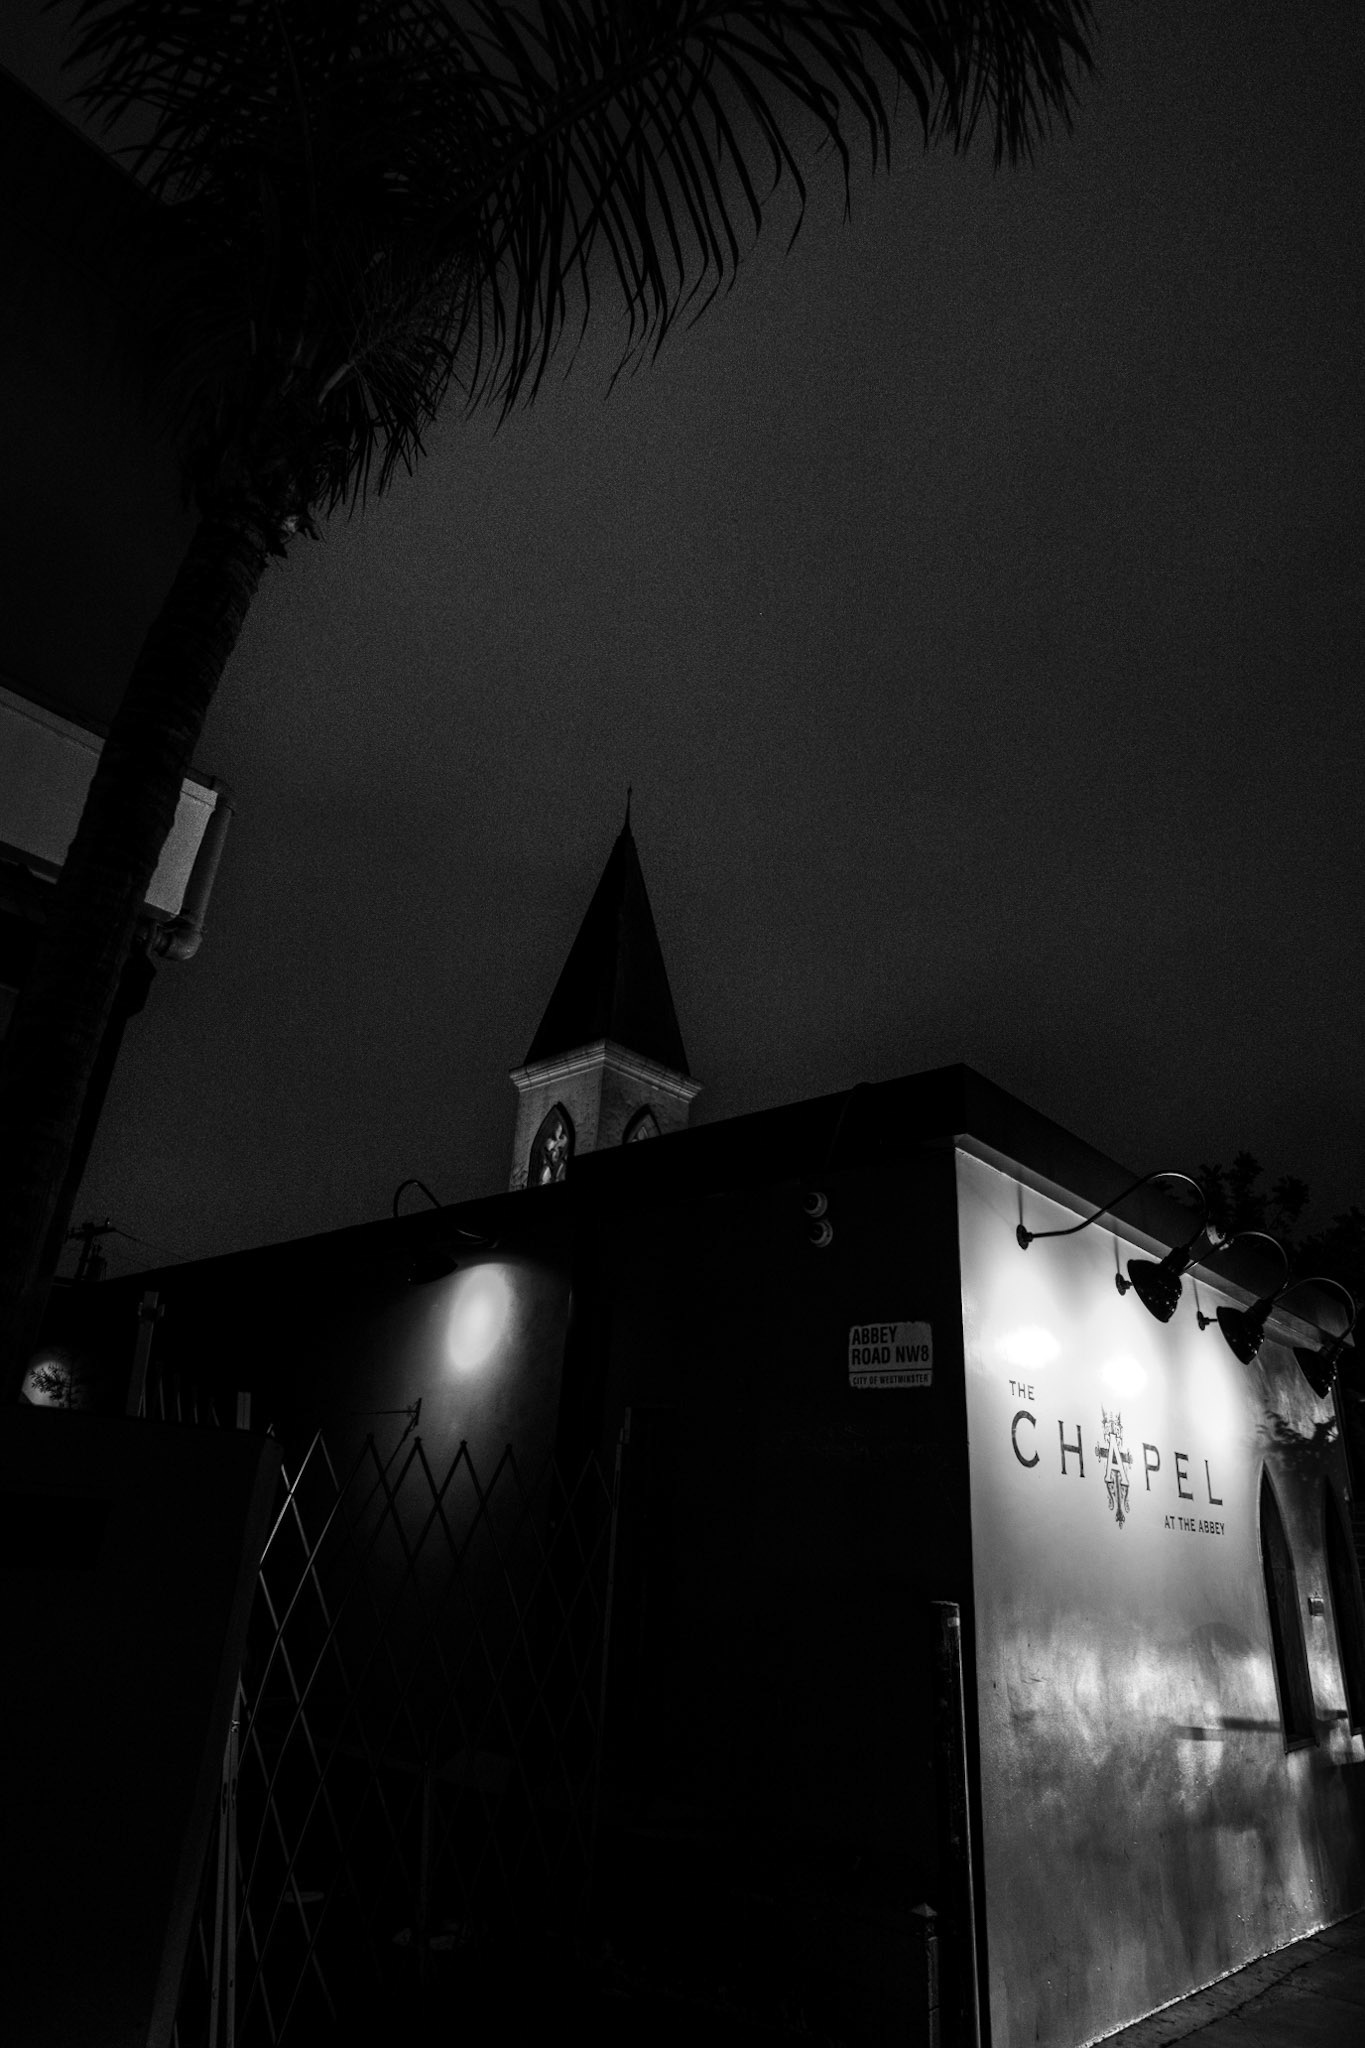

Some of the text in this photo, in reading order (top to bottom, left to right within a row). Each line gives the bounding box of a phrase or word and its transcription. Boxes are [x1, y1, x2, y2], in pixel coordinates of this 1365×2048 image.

[852, 1326, 897, 1345] ABBEY
[852, 1344, 929, 1365] ROAD NW8
[852, 1373, 929, 1385] CITY OF WESTMINSTER
[1009, 1380, 1035, 1400] THE
[1011, 1410, 1223, 1506] CHAPEL
[1165, 1515, 1225, 1536] AT THE ABBEY
